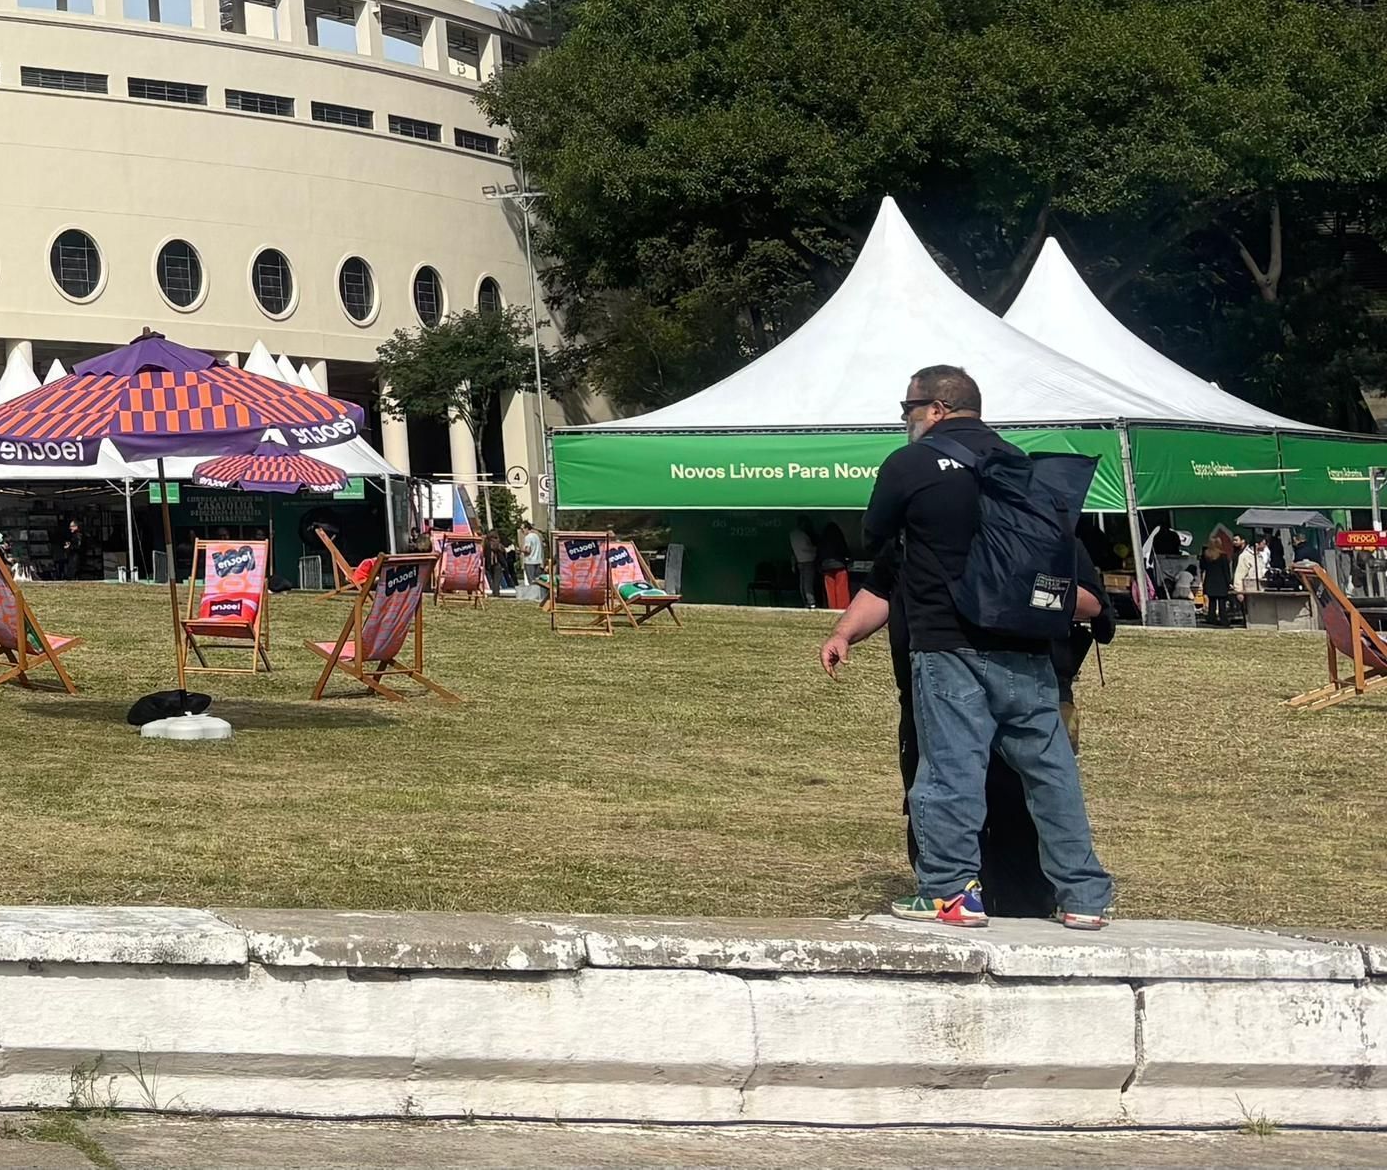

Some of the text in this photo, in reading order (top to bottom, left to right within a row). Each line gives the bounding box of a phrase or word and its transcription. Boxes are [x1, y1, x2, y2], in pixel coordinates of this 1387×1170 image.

[290, 414, 357, 445] enjoei
[513, 472, 521, 481] 4
[670, 463, 726, 479] Novos
[729, 463, 785, 479] Livros
[788, 463, 829, 479] Para
[1347, 533, 1377, 543] PIPOCA
[217, 550, 252, 570] enjoei
[387, 566, 417, 589] enjoei
[210, 602, 241, 611] enjoei
